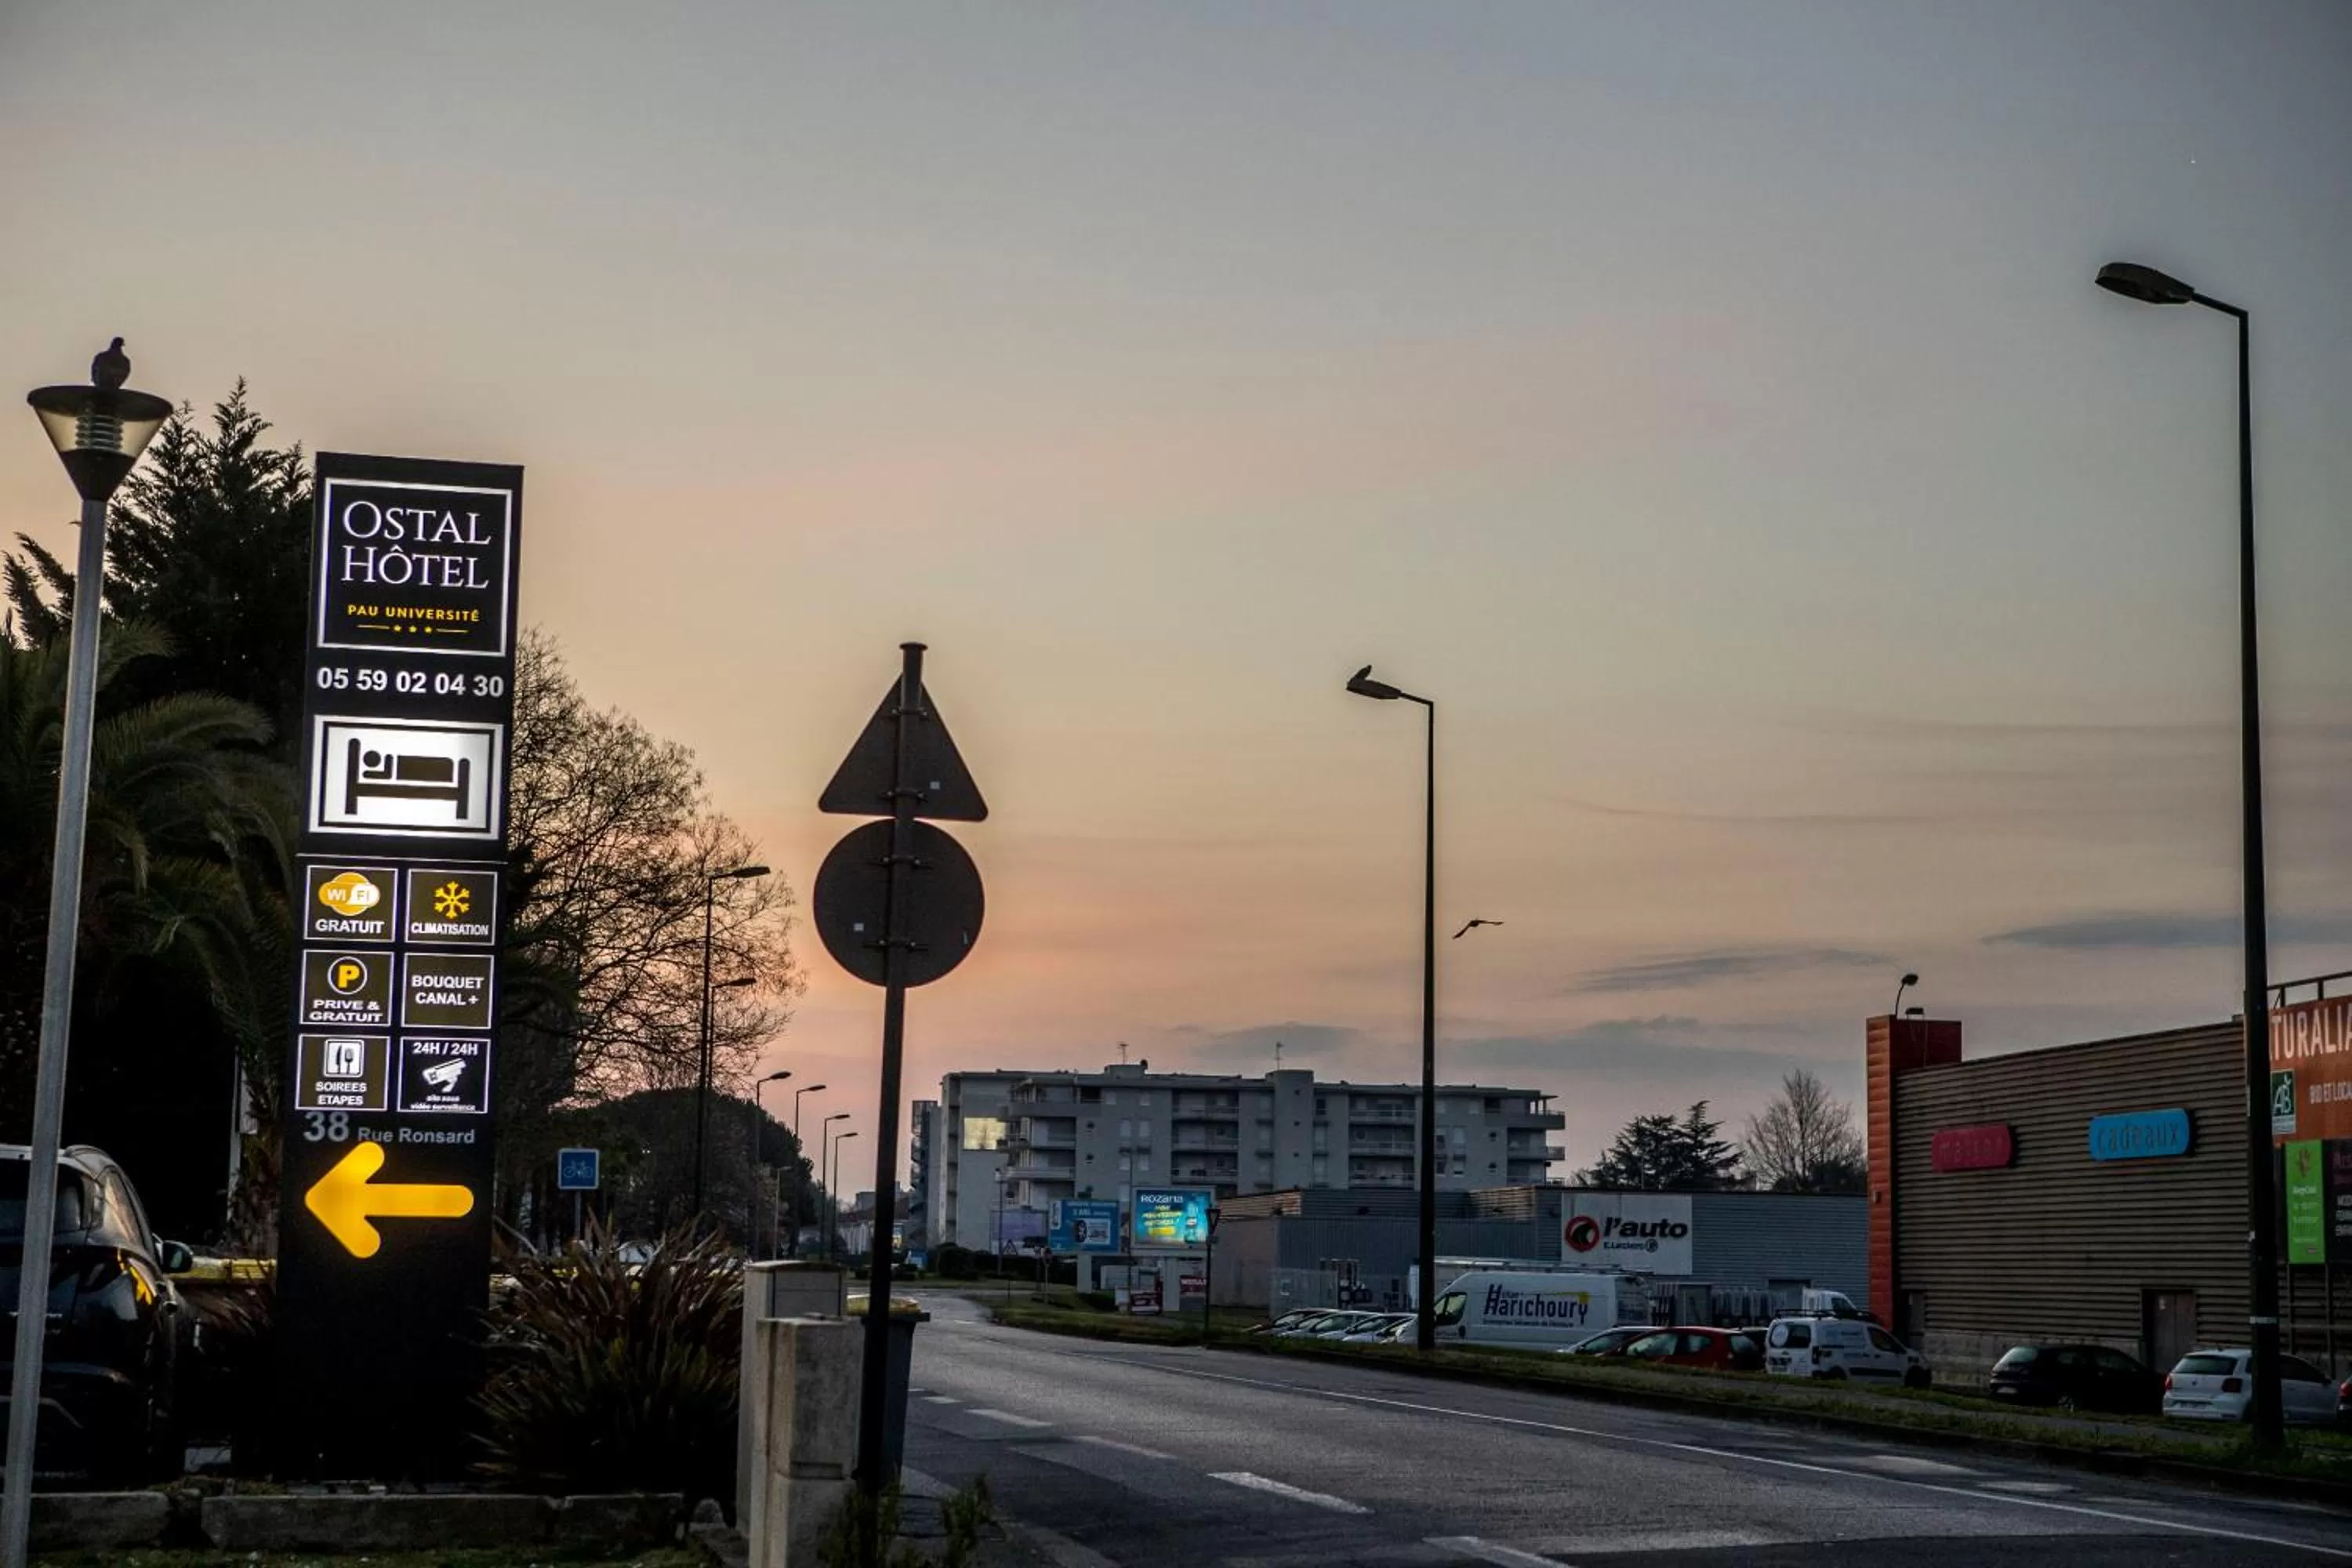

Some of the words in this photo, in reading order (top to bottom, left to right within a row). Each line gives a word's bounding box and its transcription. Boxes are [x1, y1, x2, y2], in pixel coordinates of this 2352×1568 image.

[343, 501, 492, 545] OSTAL
[341, 545, 489, 589] HÔTEL
[347, 604, 379, 616] PAU
[385, 608, 481, 622] UNIVERSITÉ
[317, 667, 349, 689] 05
[356, 670, 388, 691] 59
[395, 671, 427, 693] 02
[434, 673, 466, 695] 04
[473, 675, 504, 696] 30
[315, 920, 384, 934] GRATUIT
[411, 922, 488, 935] CLIMATISATION
[338, 965, 360, 989] P
[412, 976, 485, 989] BOUQUET
[368, 1001, 380, 1011] &
[416, 993, 466, 1005] CANAL
[469, 995, 478, 1004] +
[309, 1011, 383, 1022] GRATUIT
[413, 1043, 441, 1054] 24H
[451, 1044, 478, 1055] 24H
[303, 1112, 350, 1142] 38
[358, 1127, 393, 1142] Rue
[399, 1127, 476, 1144] Ronsard
[1604, 1217, 1688, 1238] l'auto
[1483, 1284, 1588, 1325] Harichoury
